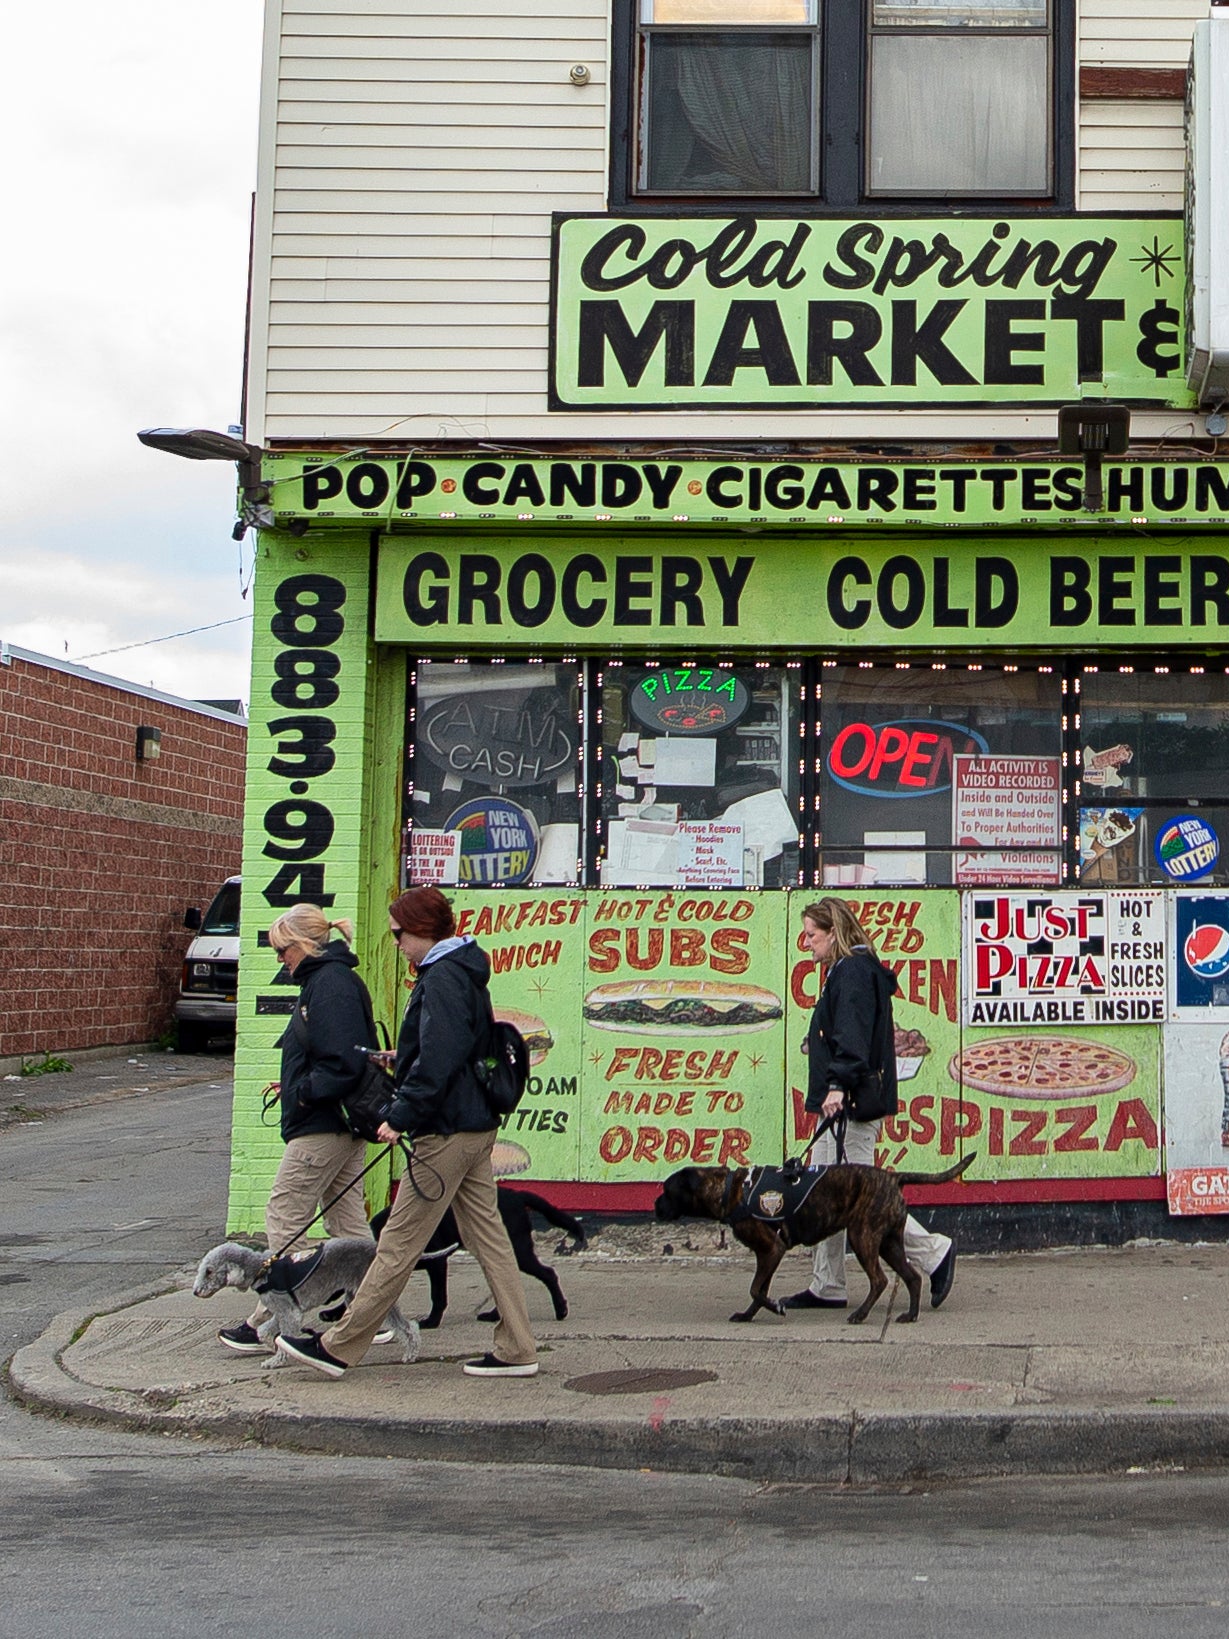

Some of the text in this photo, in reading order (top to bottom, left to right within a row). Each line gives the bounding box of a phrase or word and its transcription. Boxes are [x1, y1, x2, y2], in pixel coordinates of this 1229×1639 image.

[580, 217, 1117, 301] Cold Spring
[577, 299, 1125, 388] MARKET
[1136, 299, 1181, 378] &
[302, 462, 437, 510] POP
[463, 462, 683, 510] CANDY
[705, 465, 1084, 513] CIGARETTES
[403, 551, 756, 628] GROCERY
[826, 555, 1020, 630] COLD
[641, 670, 737, 702] PIZZA
[441, 700, 556, 750] ATM
[449, 744, 541, 779] CASH
[988, 761, 1036, 774] ACTIVITY
[1039, 762, 1049, 774] IS
[962, 774, 1055, 788] VIDEO RECORDED
[961, 790, 1055, 805] Inside and Outside
[488, 810, 520, 827] NEW
[961, 808, 1055, 819] and Will Be Handed Over
[1178, 819, 1202, 835] NEW
[412, 834, 456, 847] LOITERING
[490, 827, 528, 849] YORK
[679, 822, 742, 834] Please Remove
[961, 821, 1055, 835] To Proper Authorities
[1183, 828, 1212, 849] YORK
[460, 849, 531, 882] OTTERY
[1000, 853, 1055, 864] Violations
[1163, 840, 1217, 877] LOTTERY
[454, 900, 588, 938] EAKFAST
[593, 893, 755, 923] HOT & COLD
[849, 900, 923, 928] ESH
[980, 897, 1096, 941] JUST
[1119, 899, 1154, 919] HOT
[1131, 921, 1143, 937] &
[588, 927, 751, 975] SUBS
[1110, 941, 1164, 960] FRESH
[976, 943, 1105, 990] PIZZA
[1110, 964, 1165, 988] SLICES
[790, 959, 958, 1024] CKEN
[971, 999, 1165, 1023] AVAILABLE INSIDE
[604, 1046, 741, 1081] FRESH
[603, 1090, 746, 1117] MADE TO
[499, 1108, 569, 1134] TTIES
[939, 1096, 1159, 1157] PIZZA
[599, 1125, 753, 1166] ORDER
